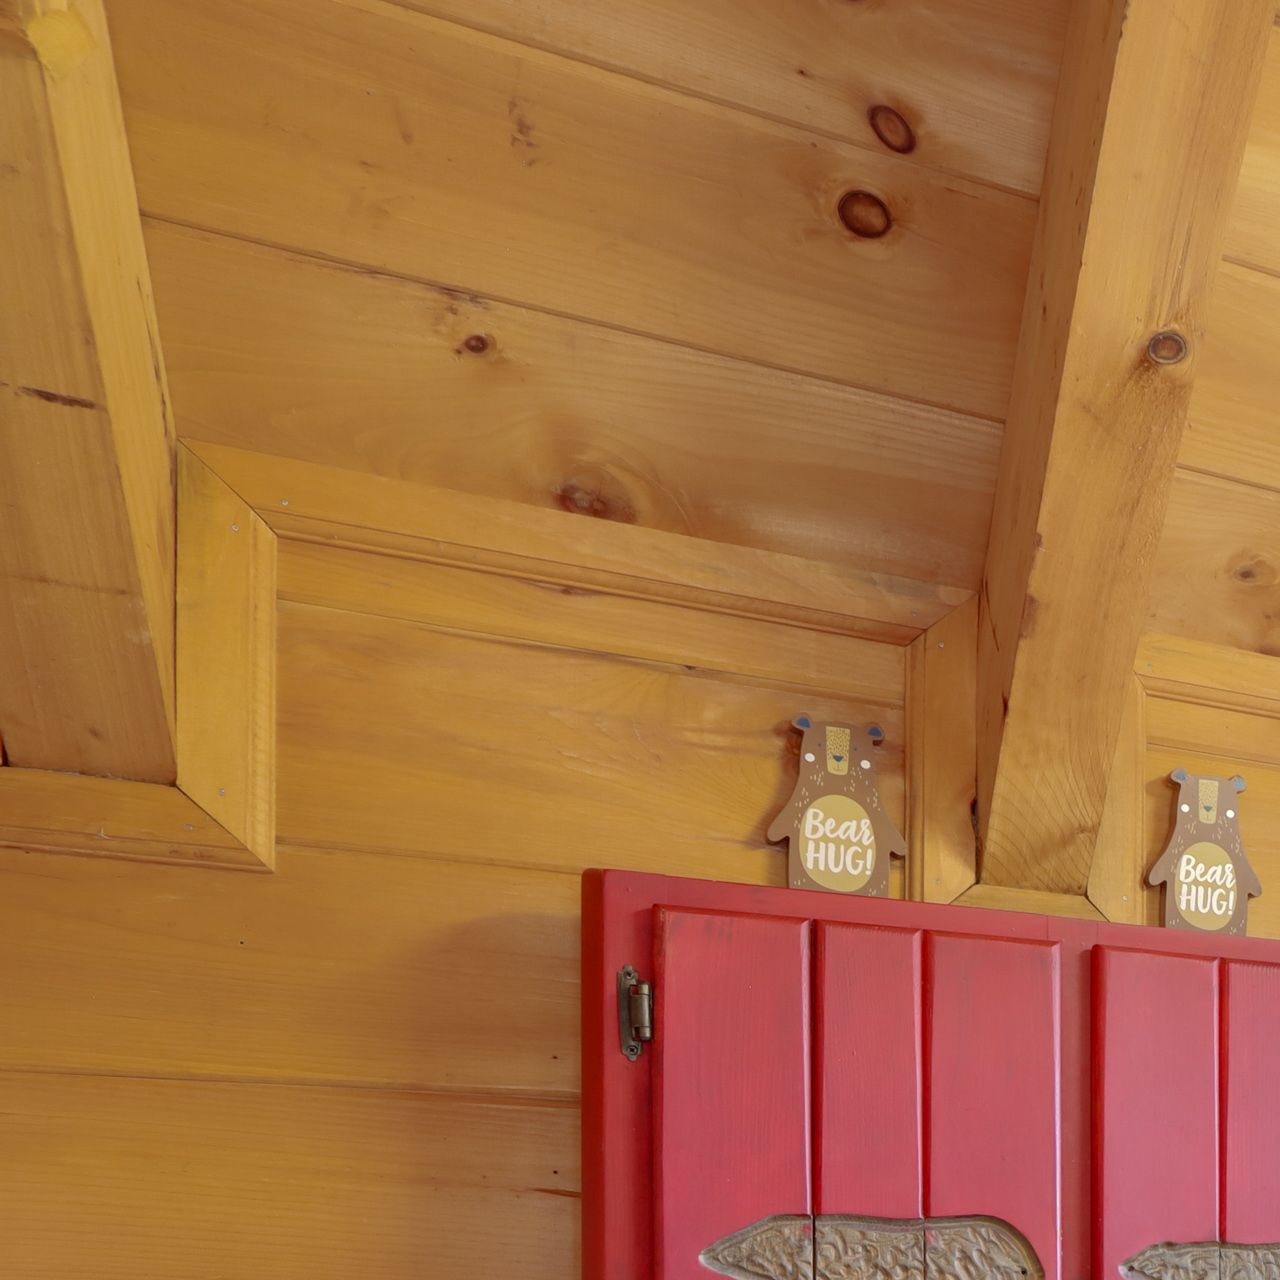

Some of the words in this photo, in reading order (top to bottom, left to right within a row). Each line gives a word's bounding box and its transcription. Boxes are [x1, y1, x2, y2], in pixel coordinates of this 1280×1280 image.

[804, 807, 874, 846] Bear
[806, 839, 873, 876] HUG!
[1179, 854, 1236, 889] Bear
[1179, 883, 1235, 916] HUG!
